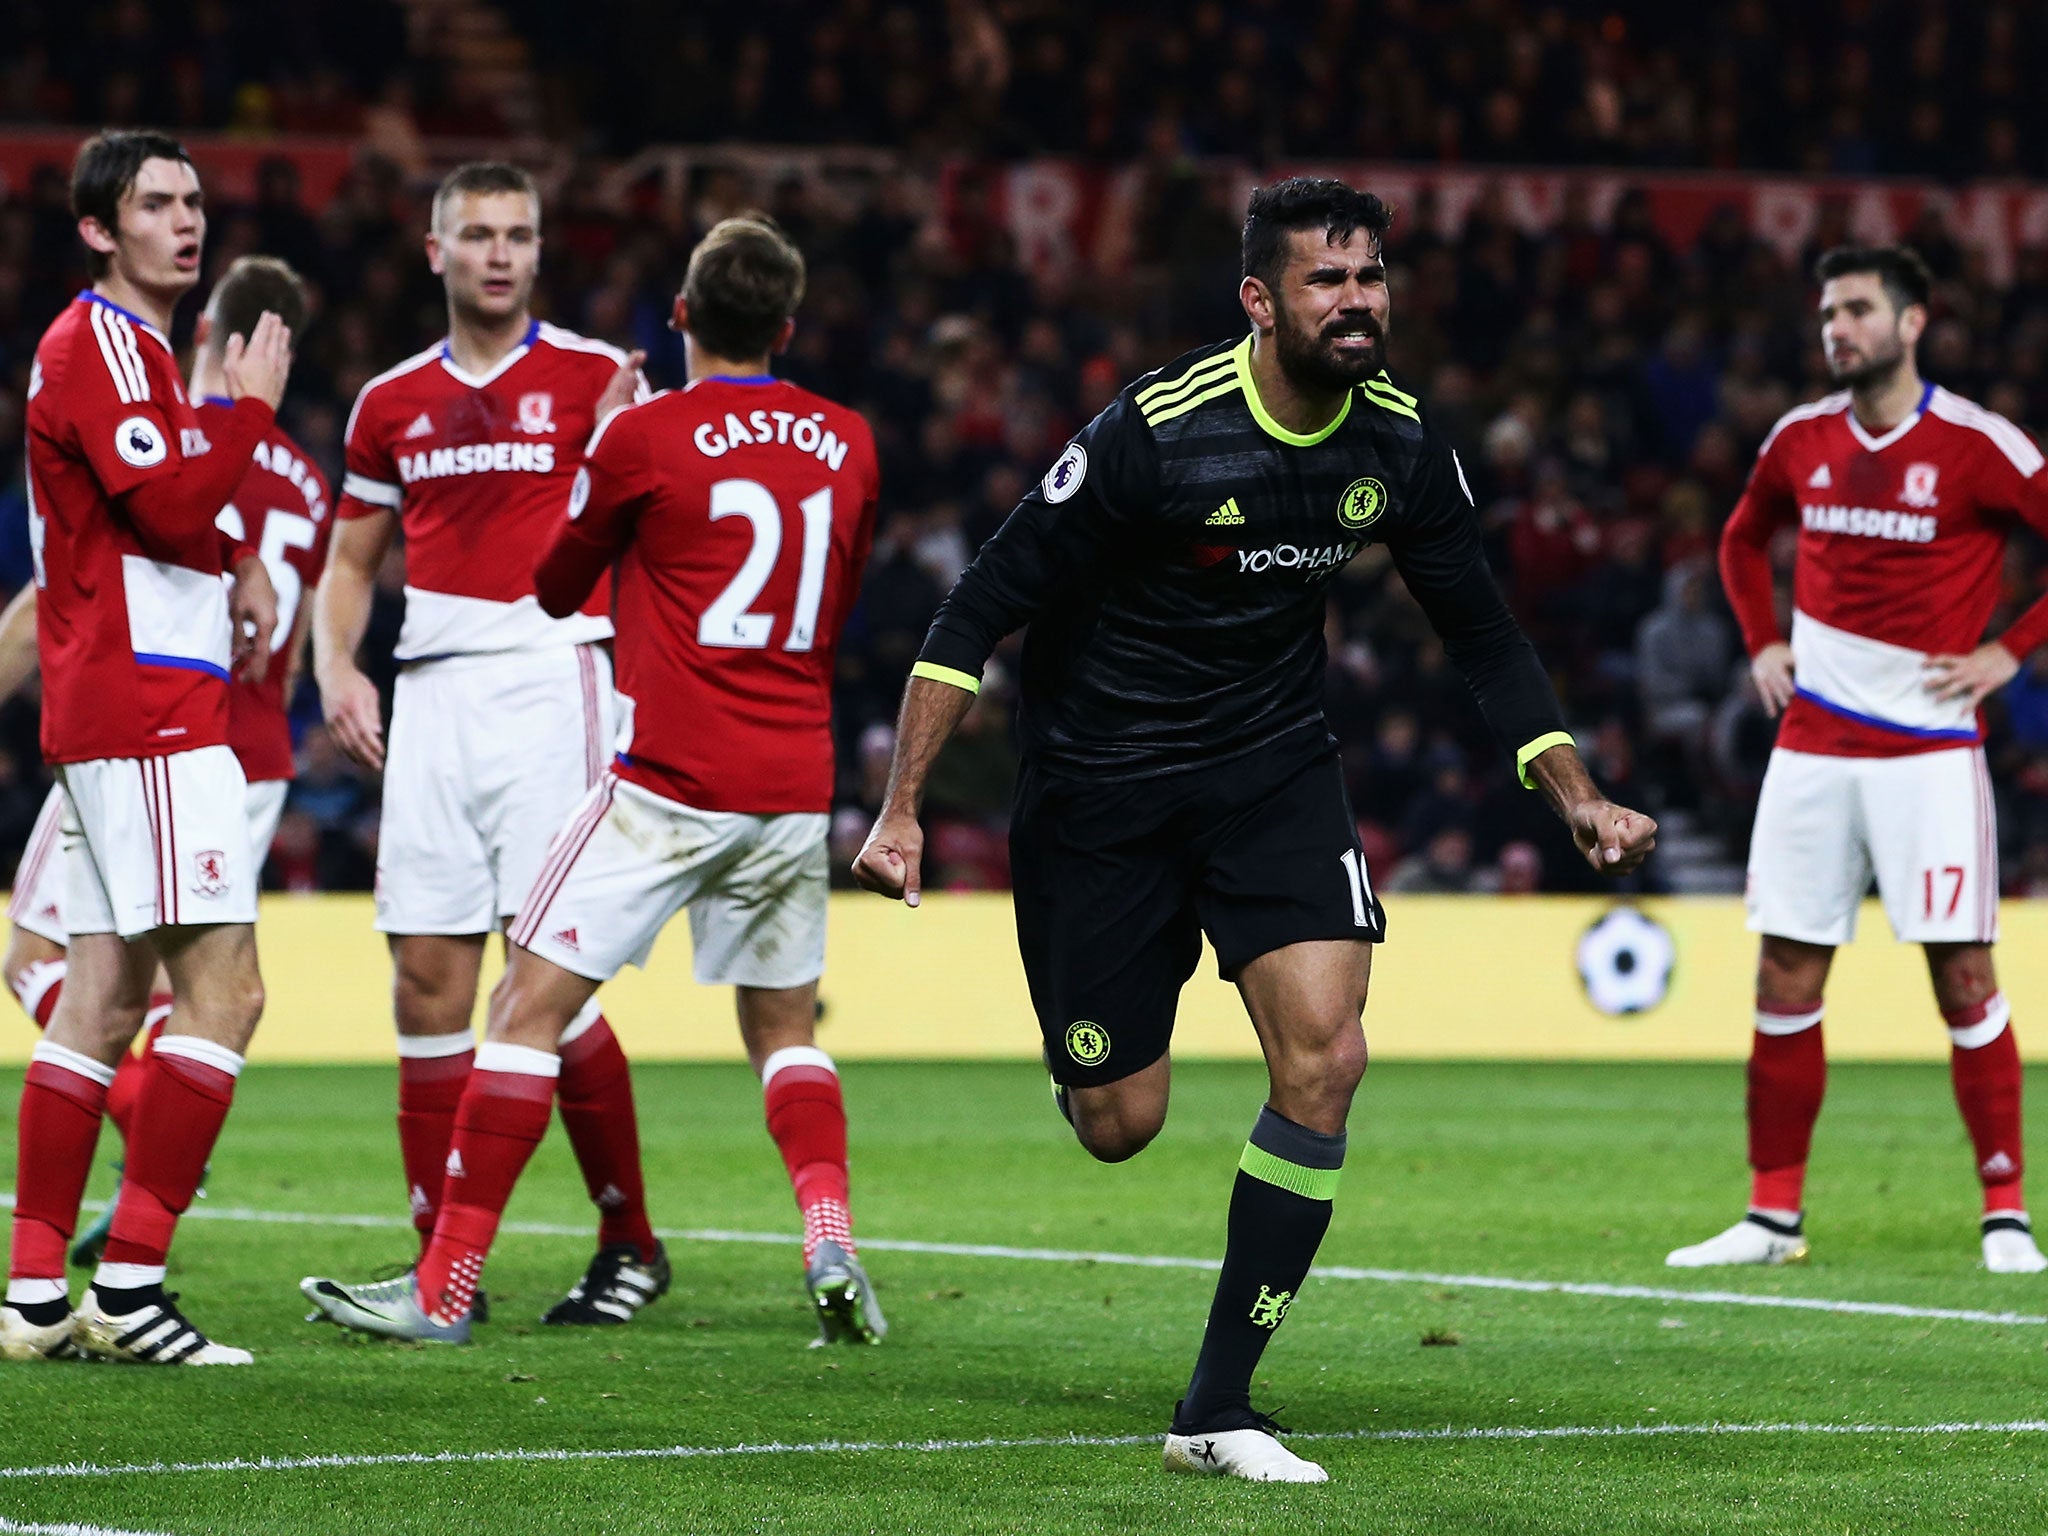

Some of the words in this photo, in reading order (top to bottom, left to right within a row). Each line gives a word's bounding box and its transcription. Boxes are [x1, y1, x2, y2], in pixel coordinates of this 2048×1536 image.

[693, 410, 848, 471] GASTÓN
[1205, 514, 1246, 526] adidas
[697, 477, 833, 652] 21
[1238, 541, 1358, 573] YOOHAM
[1924, 866, 1964, 919] 17
